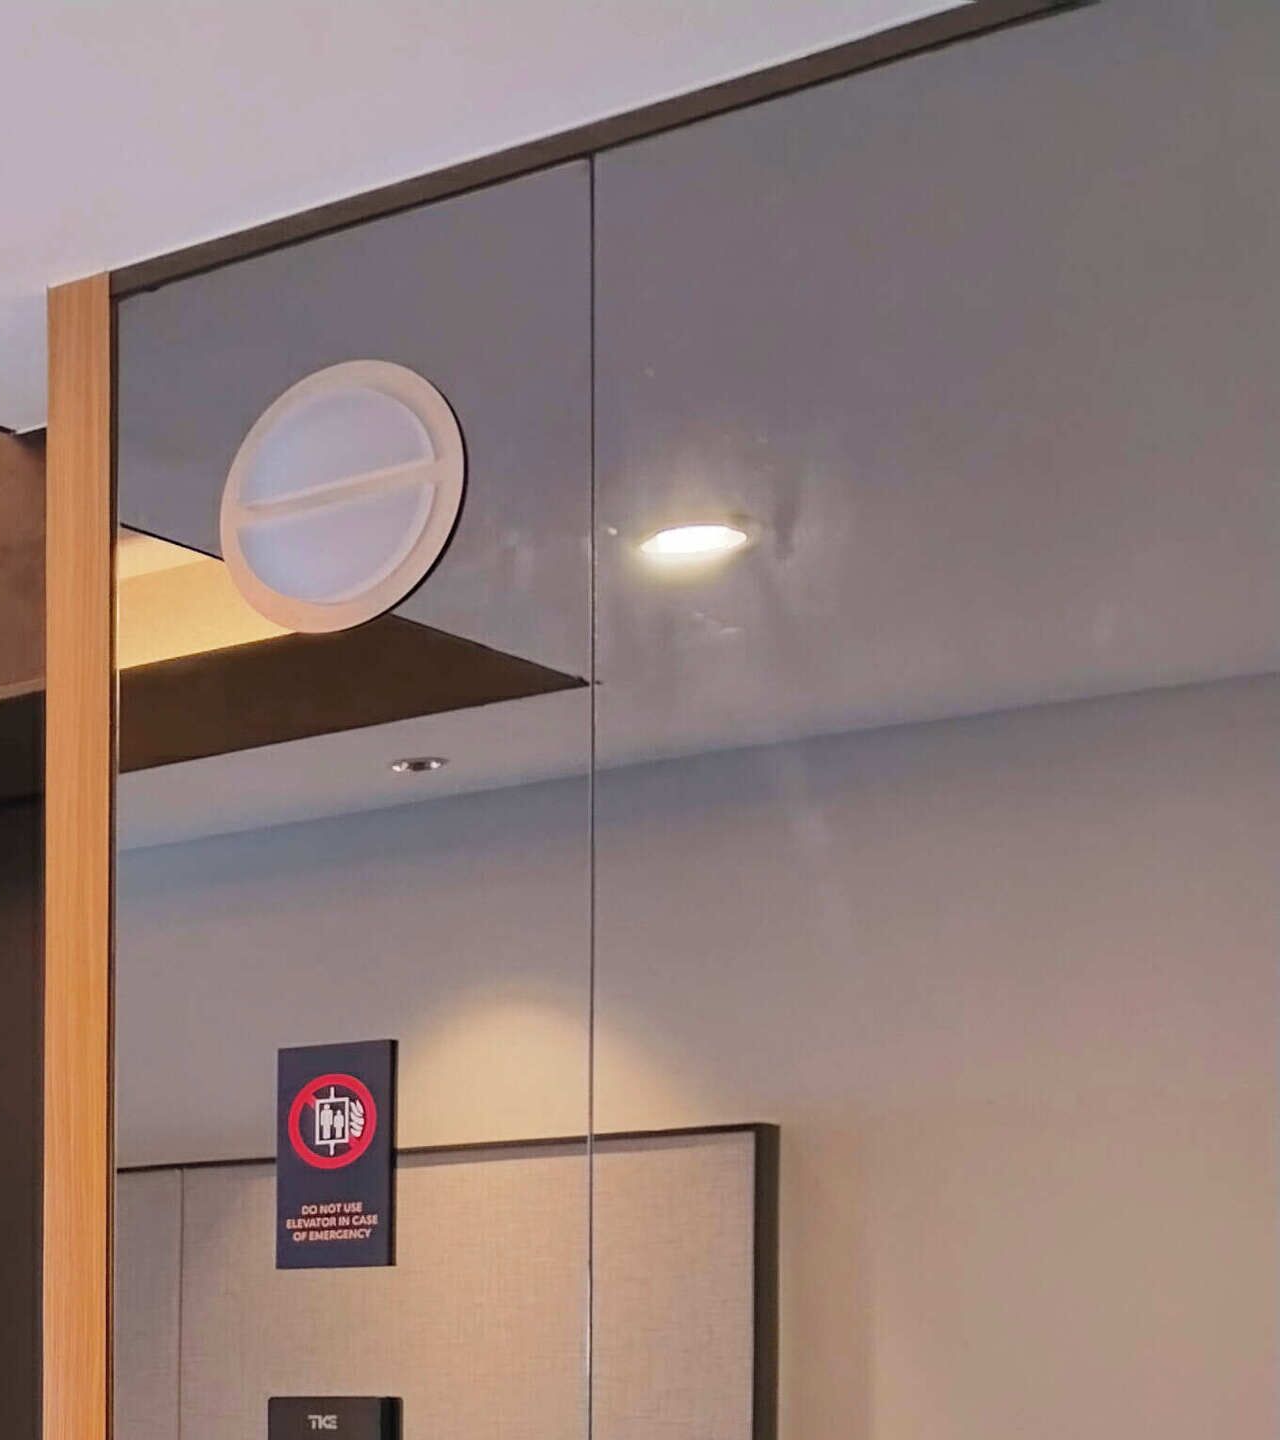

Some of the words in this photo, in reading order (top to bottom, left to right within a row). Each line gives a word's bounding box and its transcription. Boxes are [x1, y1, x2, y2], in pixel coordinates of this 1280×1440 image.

[301, 1204, 318, 1215] DO
[320, 1203, 341, 1213] NOT
[343, 1202, 362, 1212] USE
[286, 1217, 336, 1229] ELEVATOR
[338, 1215, 350, 1226] IN
[351, 1214, 378, 1226] CASE
[293, 1231, 307, 1242] OF
[309, 1229, 371, 1240] EMERGENCY
[307, 1414, 338, 1430] TKE
